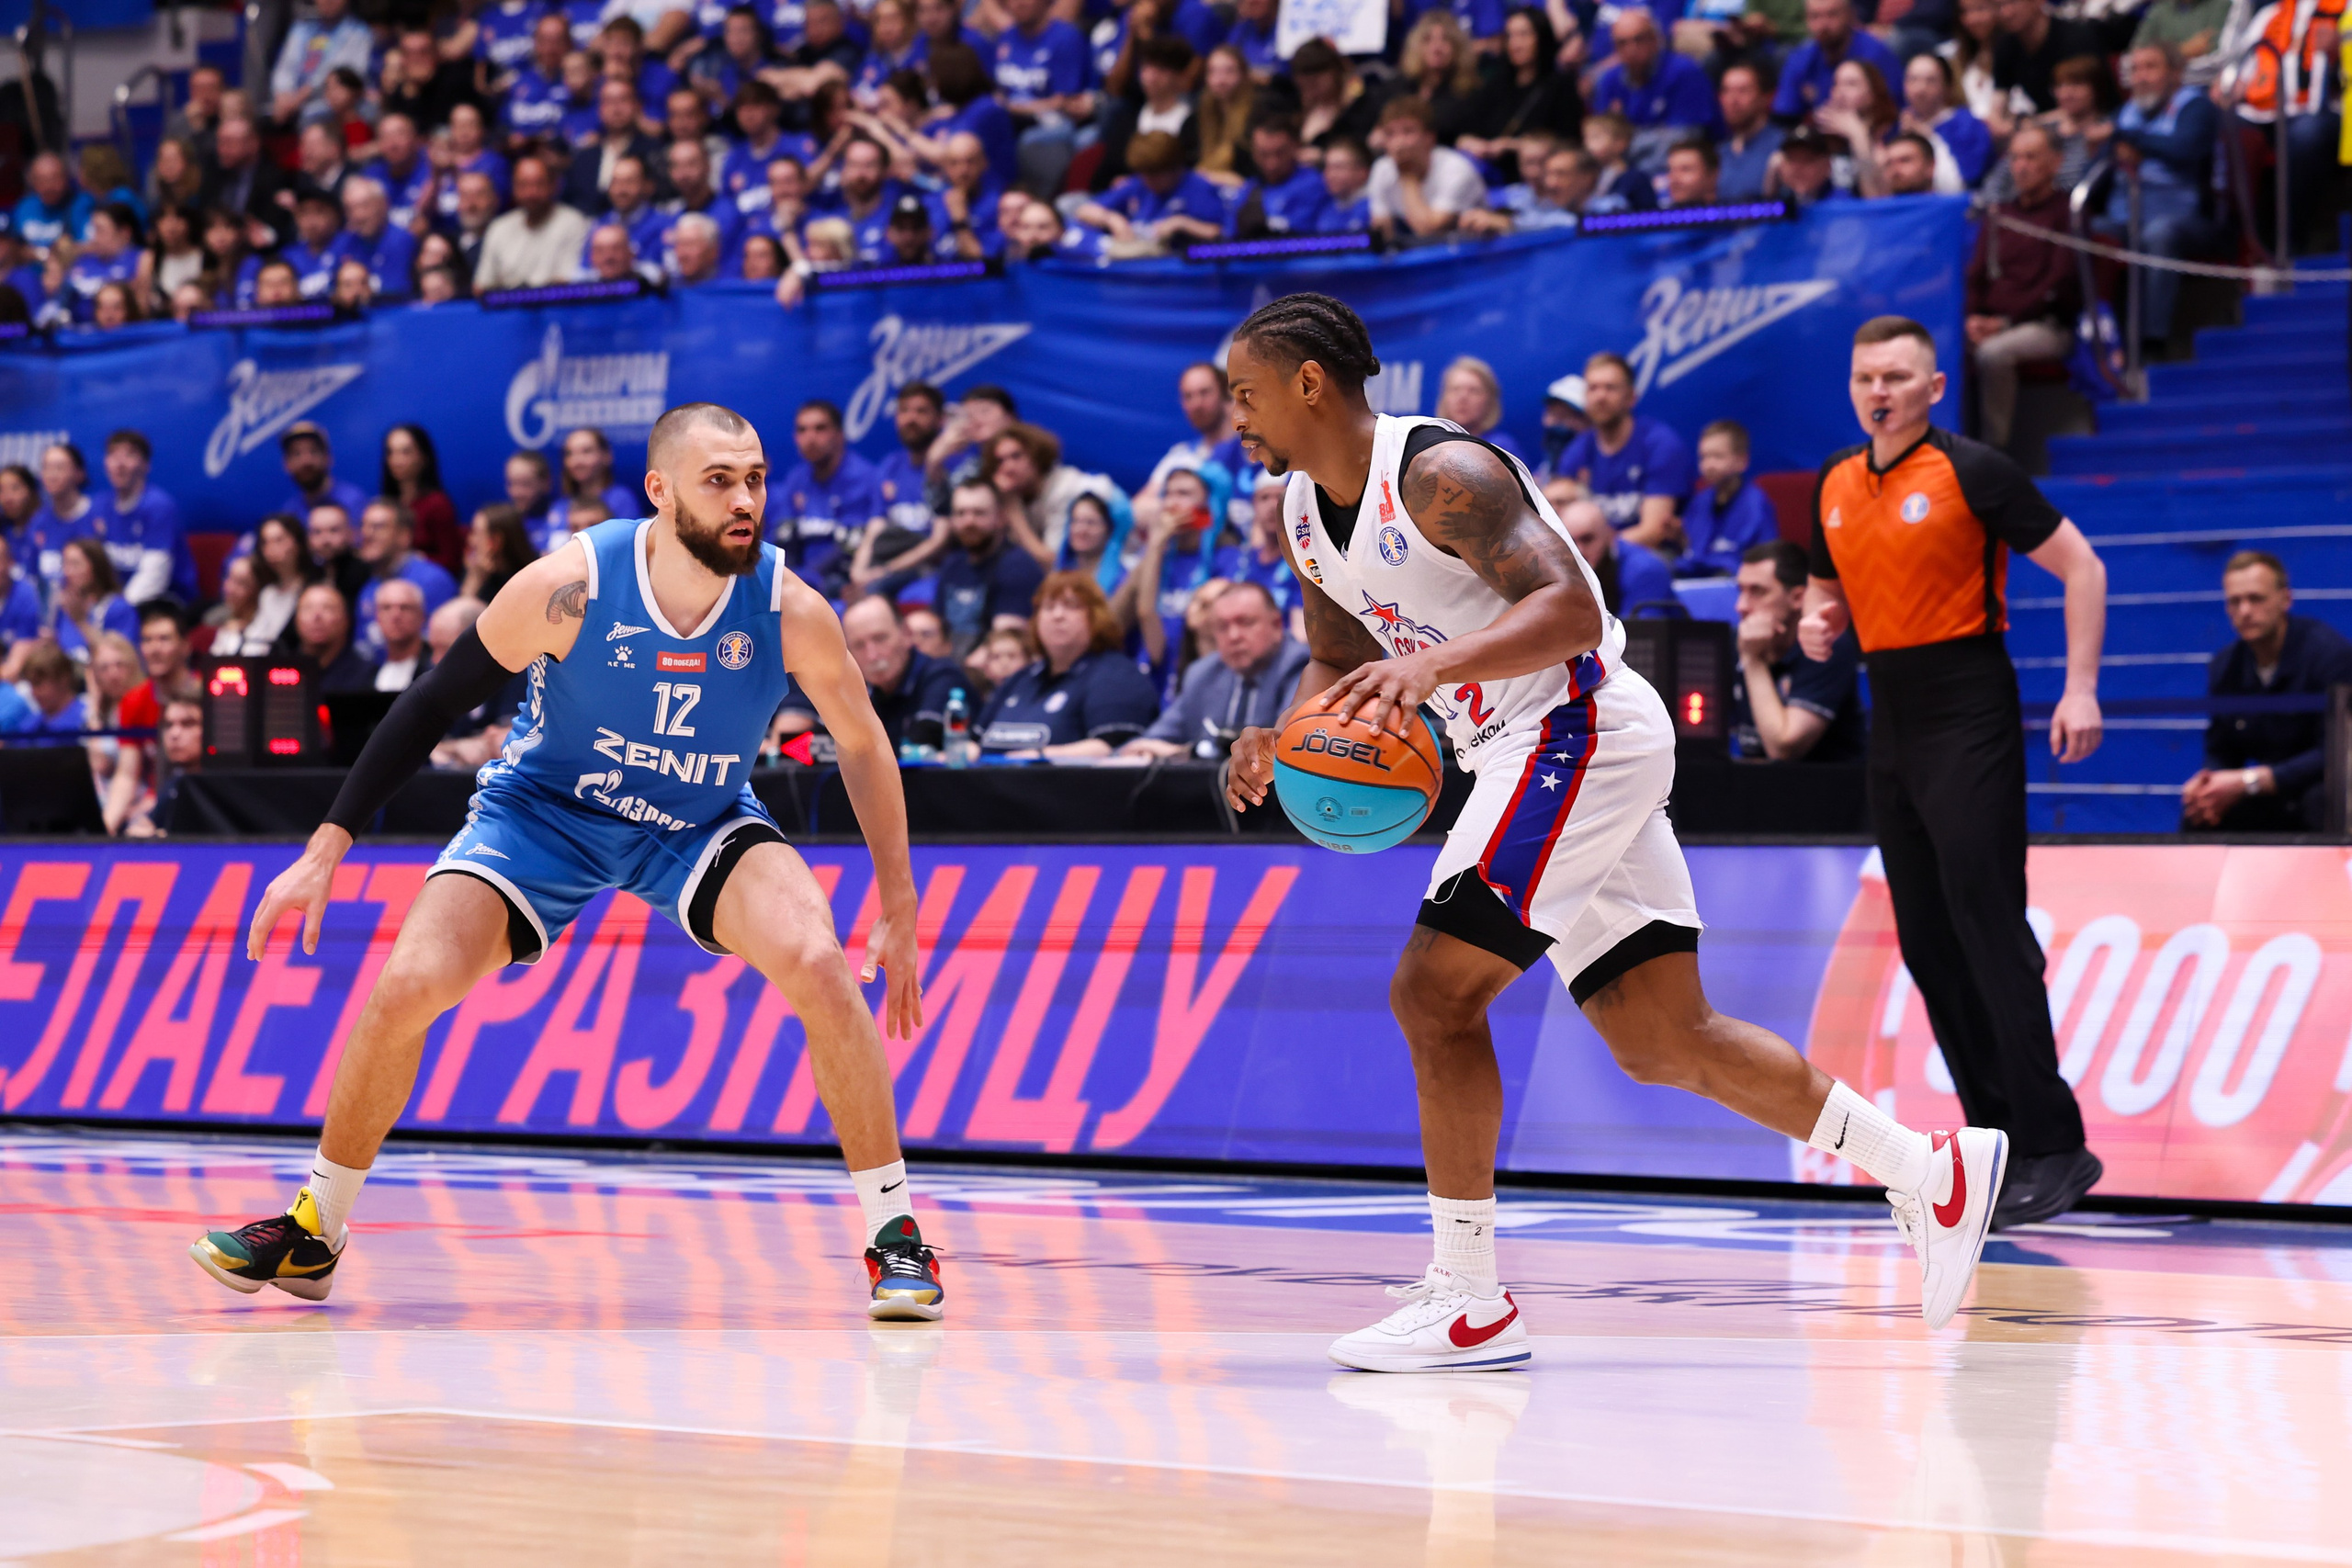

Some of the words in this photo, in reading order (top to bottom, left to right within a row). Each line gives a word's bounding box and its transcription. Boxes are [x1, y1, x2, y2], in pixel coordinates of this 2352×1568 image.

[1296, 526, 1310, 536] CSK
[652, 682, 702, 737] 12
[593, 727, 741, 786] ZENIT
[1291, 728, 1391, 772] JÖGEL
[1925, 906, 2322, 1128] 000
[1475, 1226, 1482, 1236] 2
